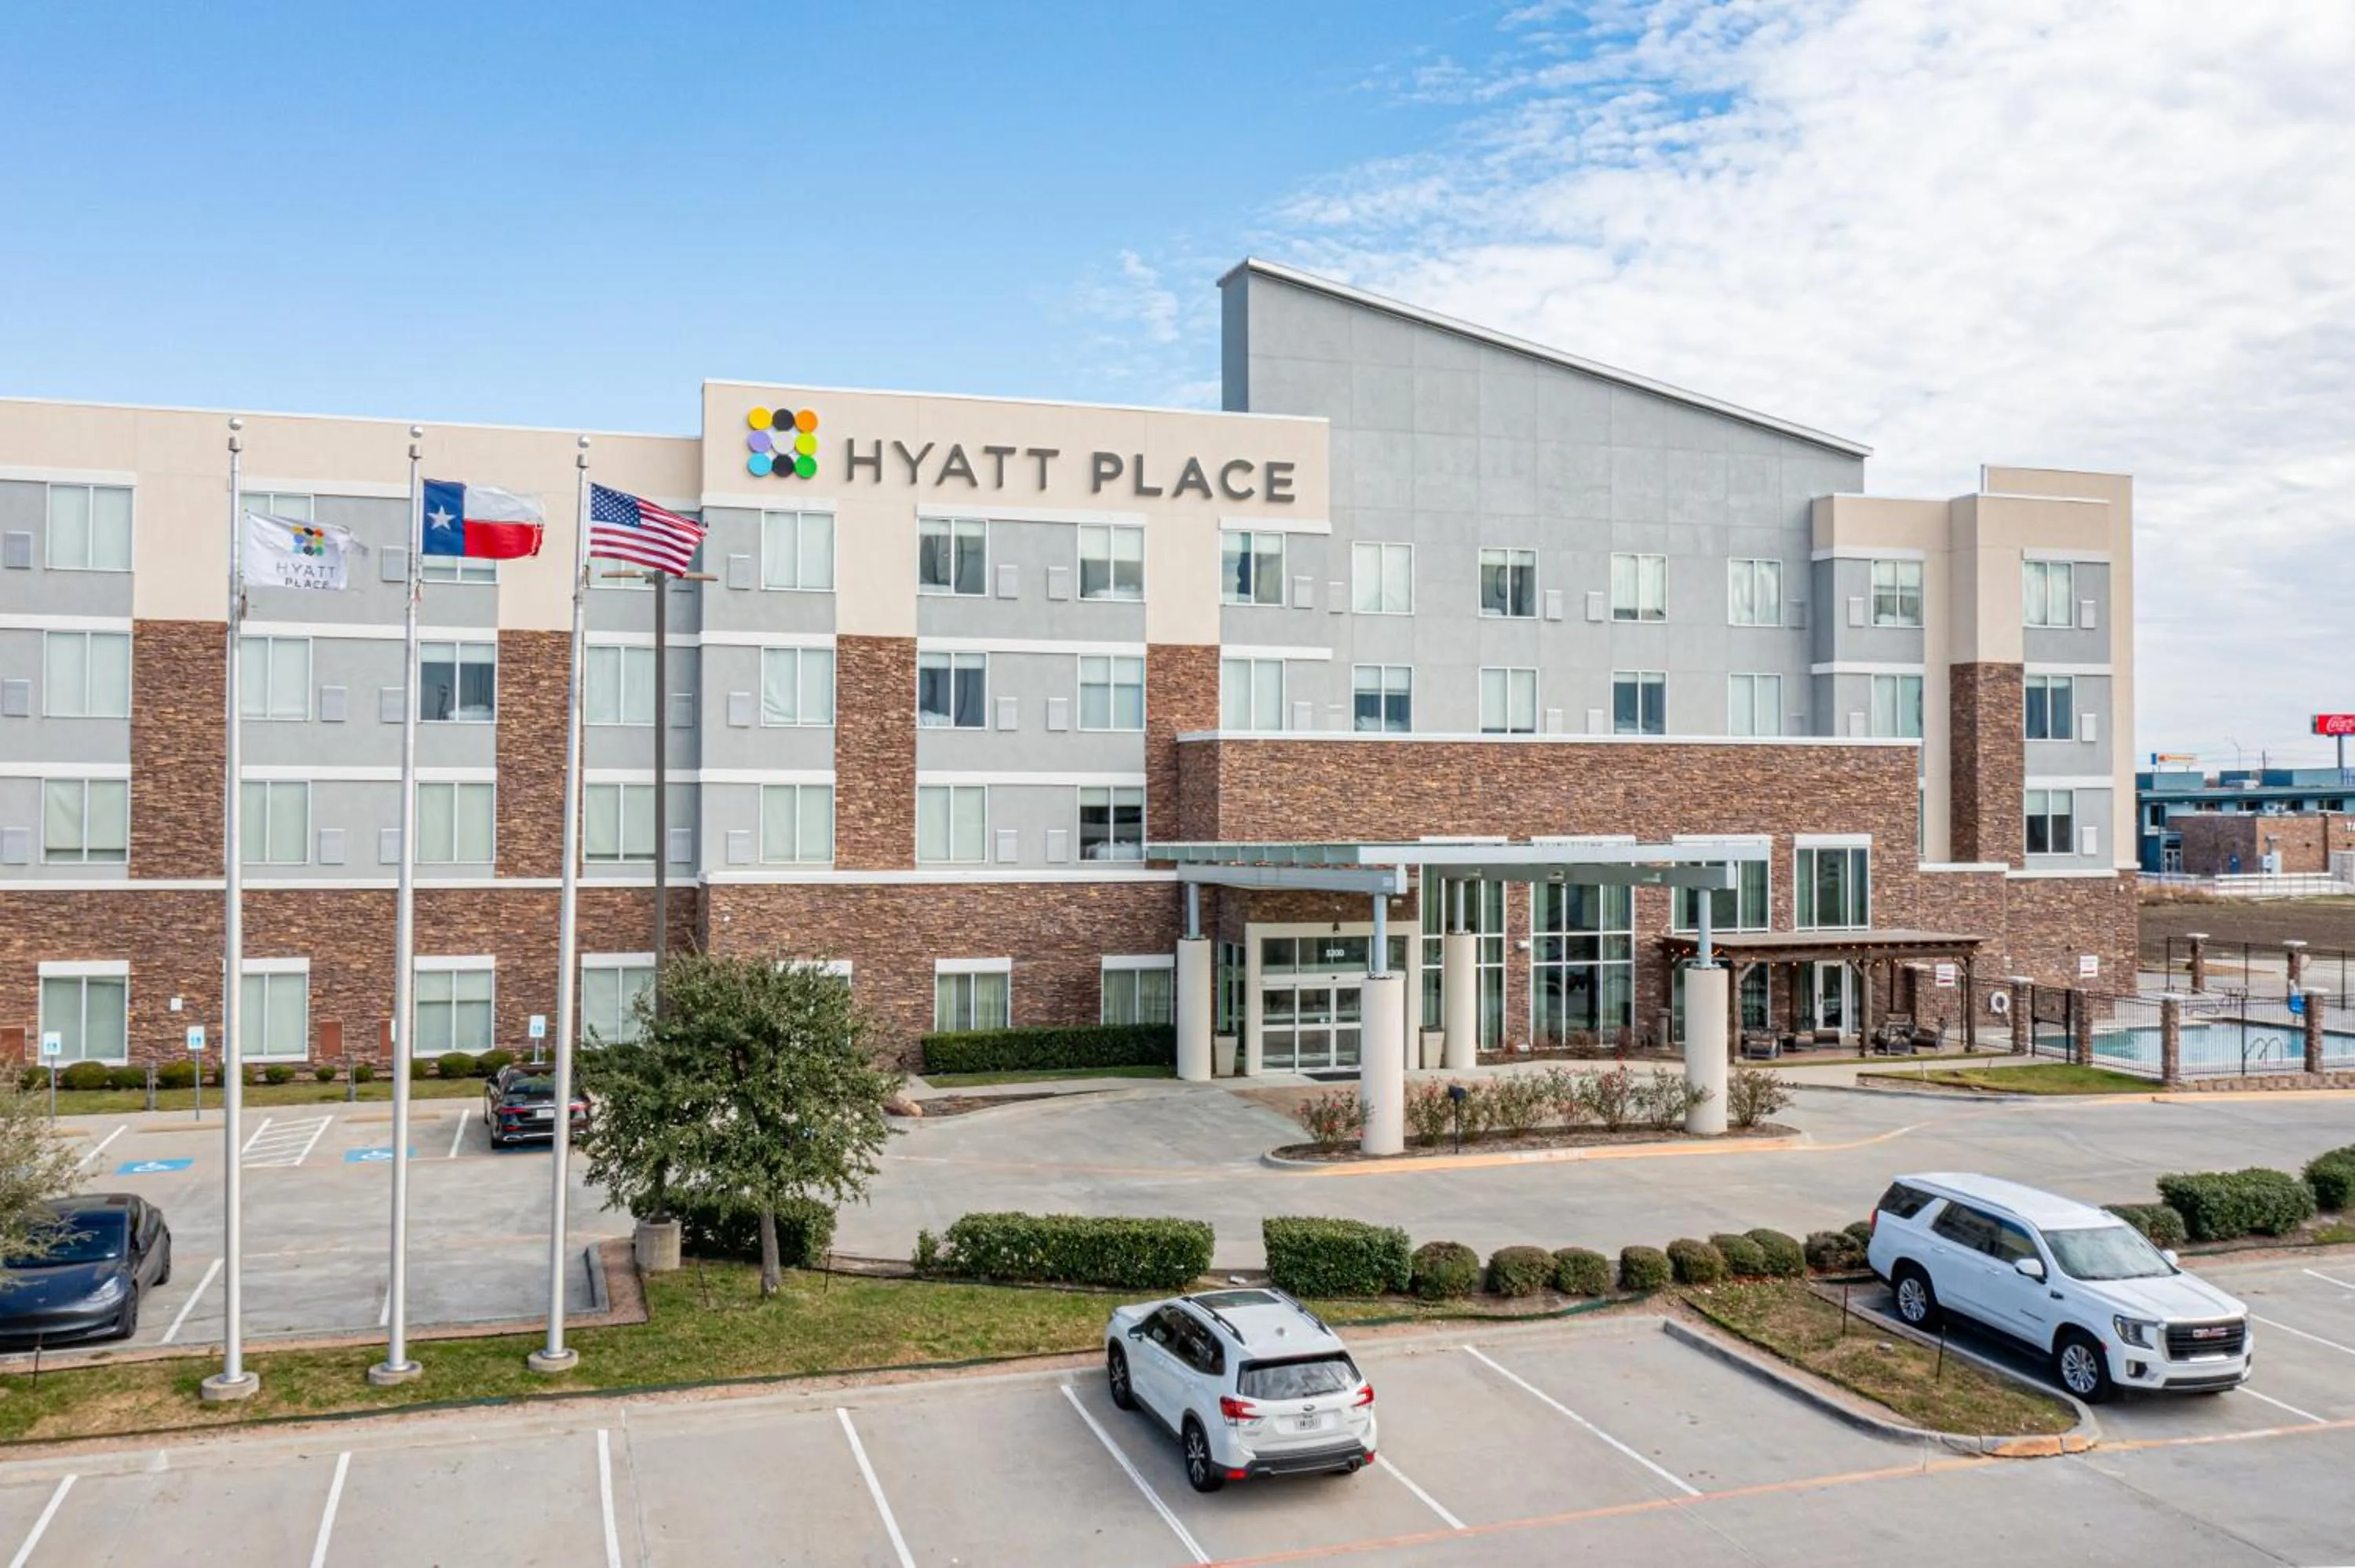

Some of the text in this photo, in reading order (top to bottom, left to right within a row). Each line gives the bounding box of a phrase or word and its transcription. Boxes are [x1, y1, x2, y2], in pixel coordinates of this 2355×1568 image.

[846, 437, 1295, 503] HYATT PLACE
[276, 560, 336, 578] HYATT
[285, 577, 329, 589] PLACE
[2193, 1326, 2228, 1338] GMC
